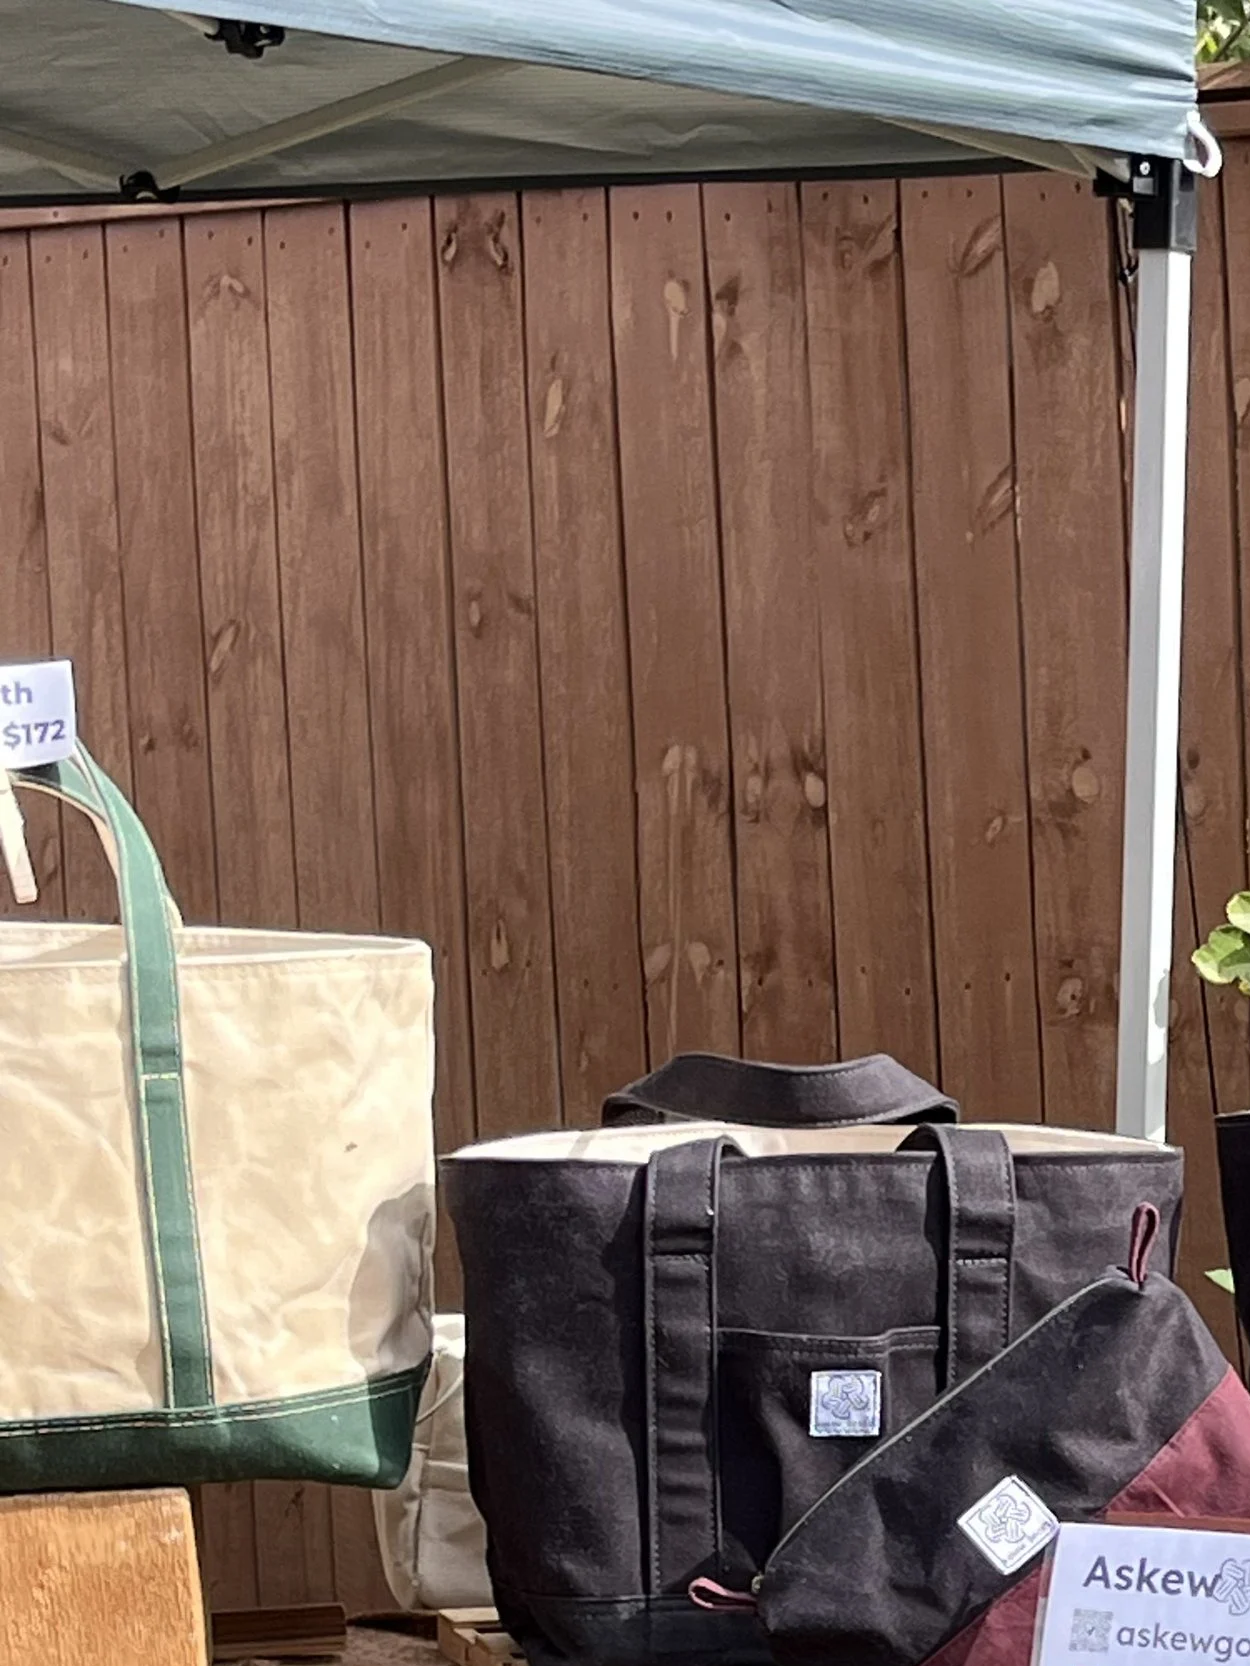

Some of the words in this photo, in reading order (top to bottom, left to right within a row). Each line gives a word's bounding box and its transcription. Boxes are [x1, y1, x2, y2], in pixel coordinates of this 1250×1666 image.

[1, 680, 33, 705] th
[3, 719, 66, 750] $172
[1082, 1555, 1218, 1599] Askew
